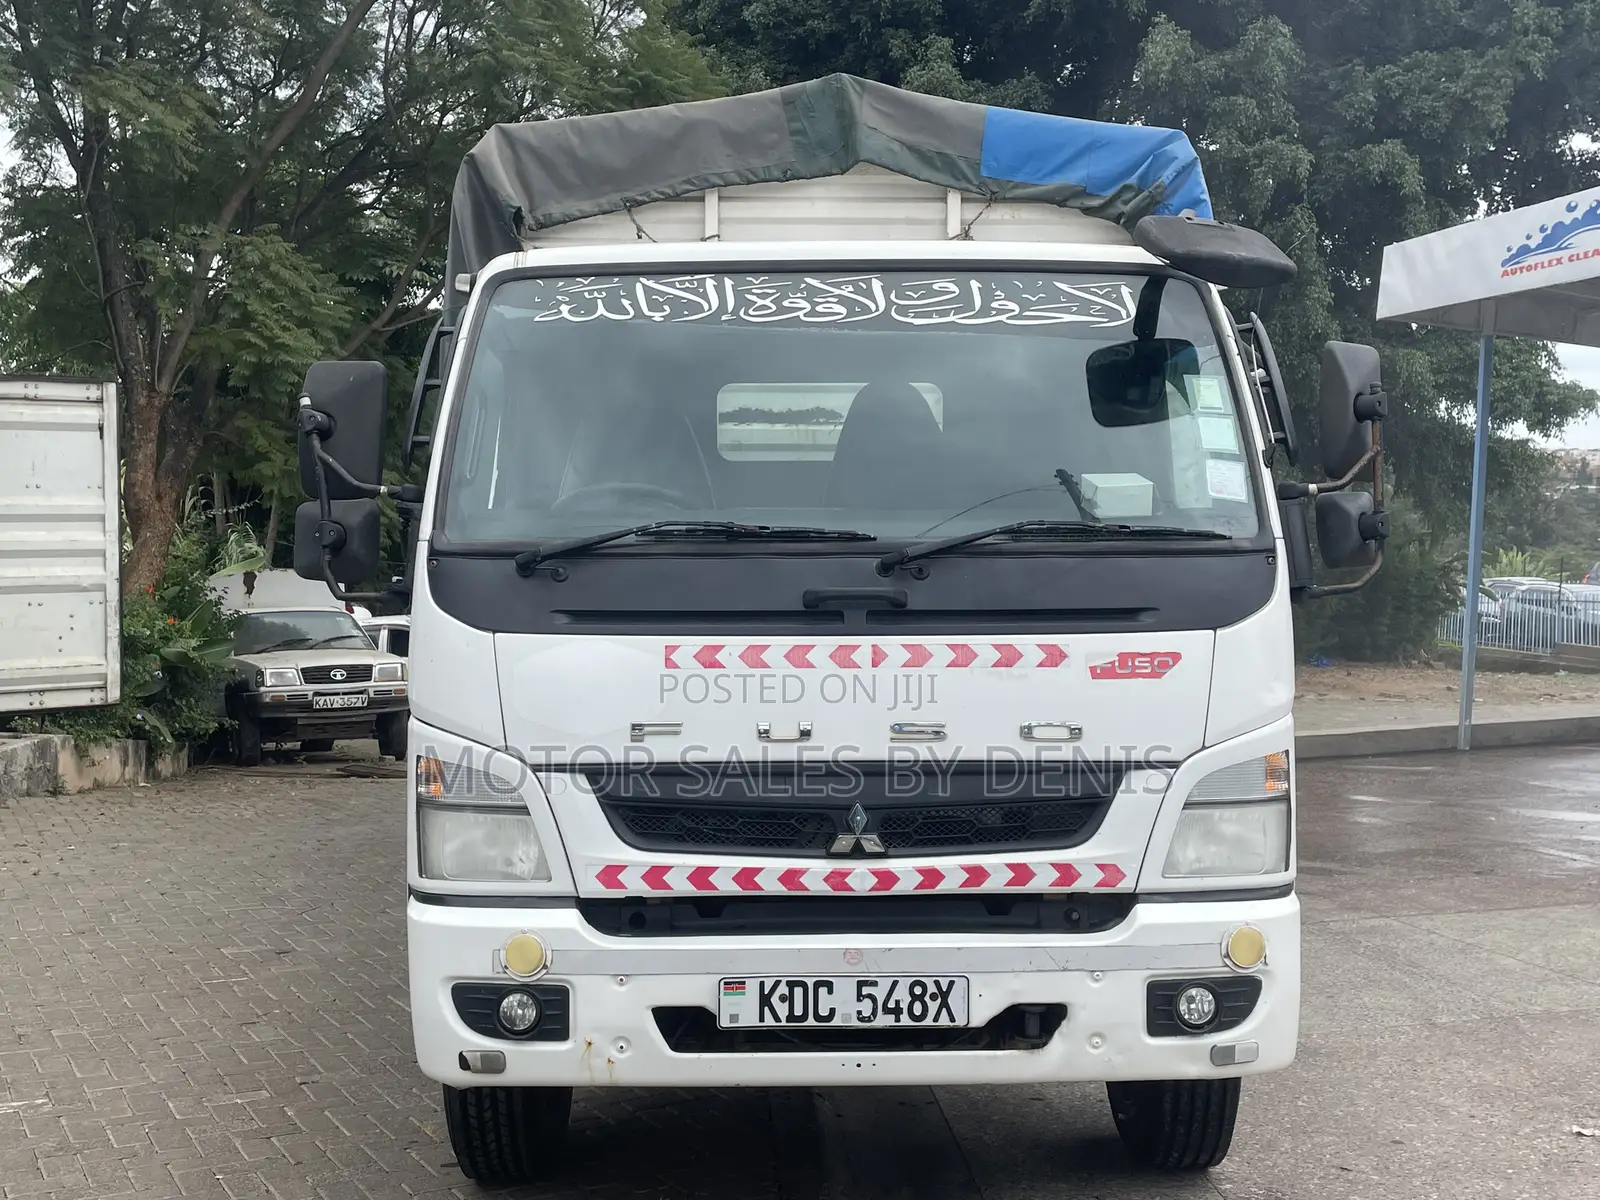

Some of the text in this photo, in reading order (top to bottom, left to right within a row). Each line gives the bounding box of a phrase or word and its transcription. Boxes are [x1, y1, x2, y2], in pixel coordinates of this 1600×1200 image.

[1501, 257, 1563, 278] AUTOFLEX
[630, 721, 1083, 742] FUSO
[758, 979, 836, 1024] KDC
[856, 979, 957, 1023] 548X
